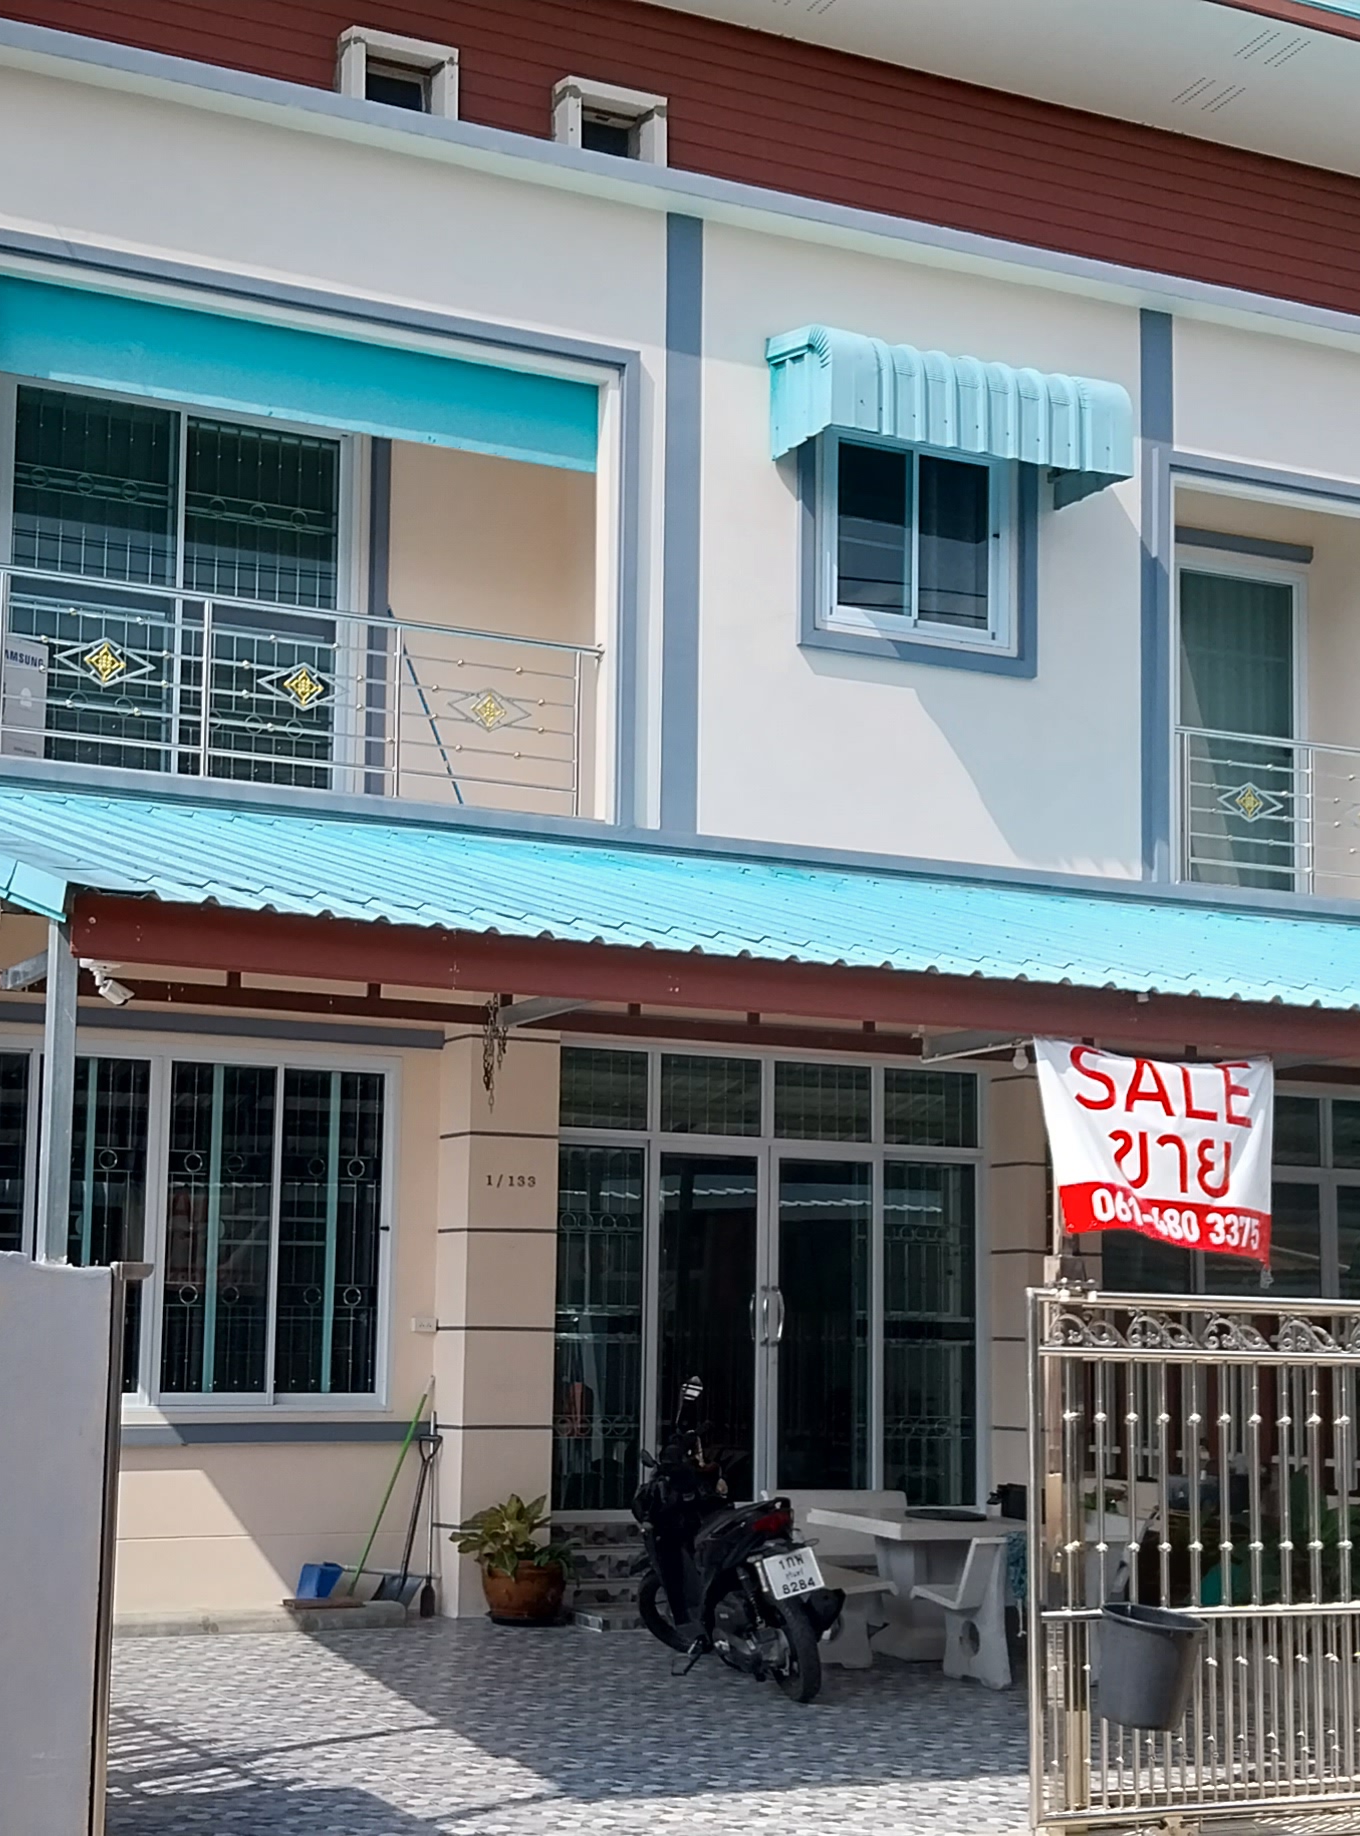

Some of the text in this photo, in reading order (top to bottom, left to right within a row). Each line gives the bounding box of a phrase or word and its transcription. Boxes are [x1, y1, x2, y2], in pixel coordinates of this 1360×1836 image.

[4, 649, 44, 667] AMSUNG
[1070, 1045, 1252, 1128] SALE
[1108, 1129, 1232, 1198] ขาย
[1091, 1188, 1260, 1250] 061-480 3375
[782, 1577, 816, 1595] 8284
